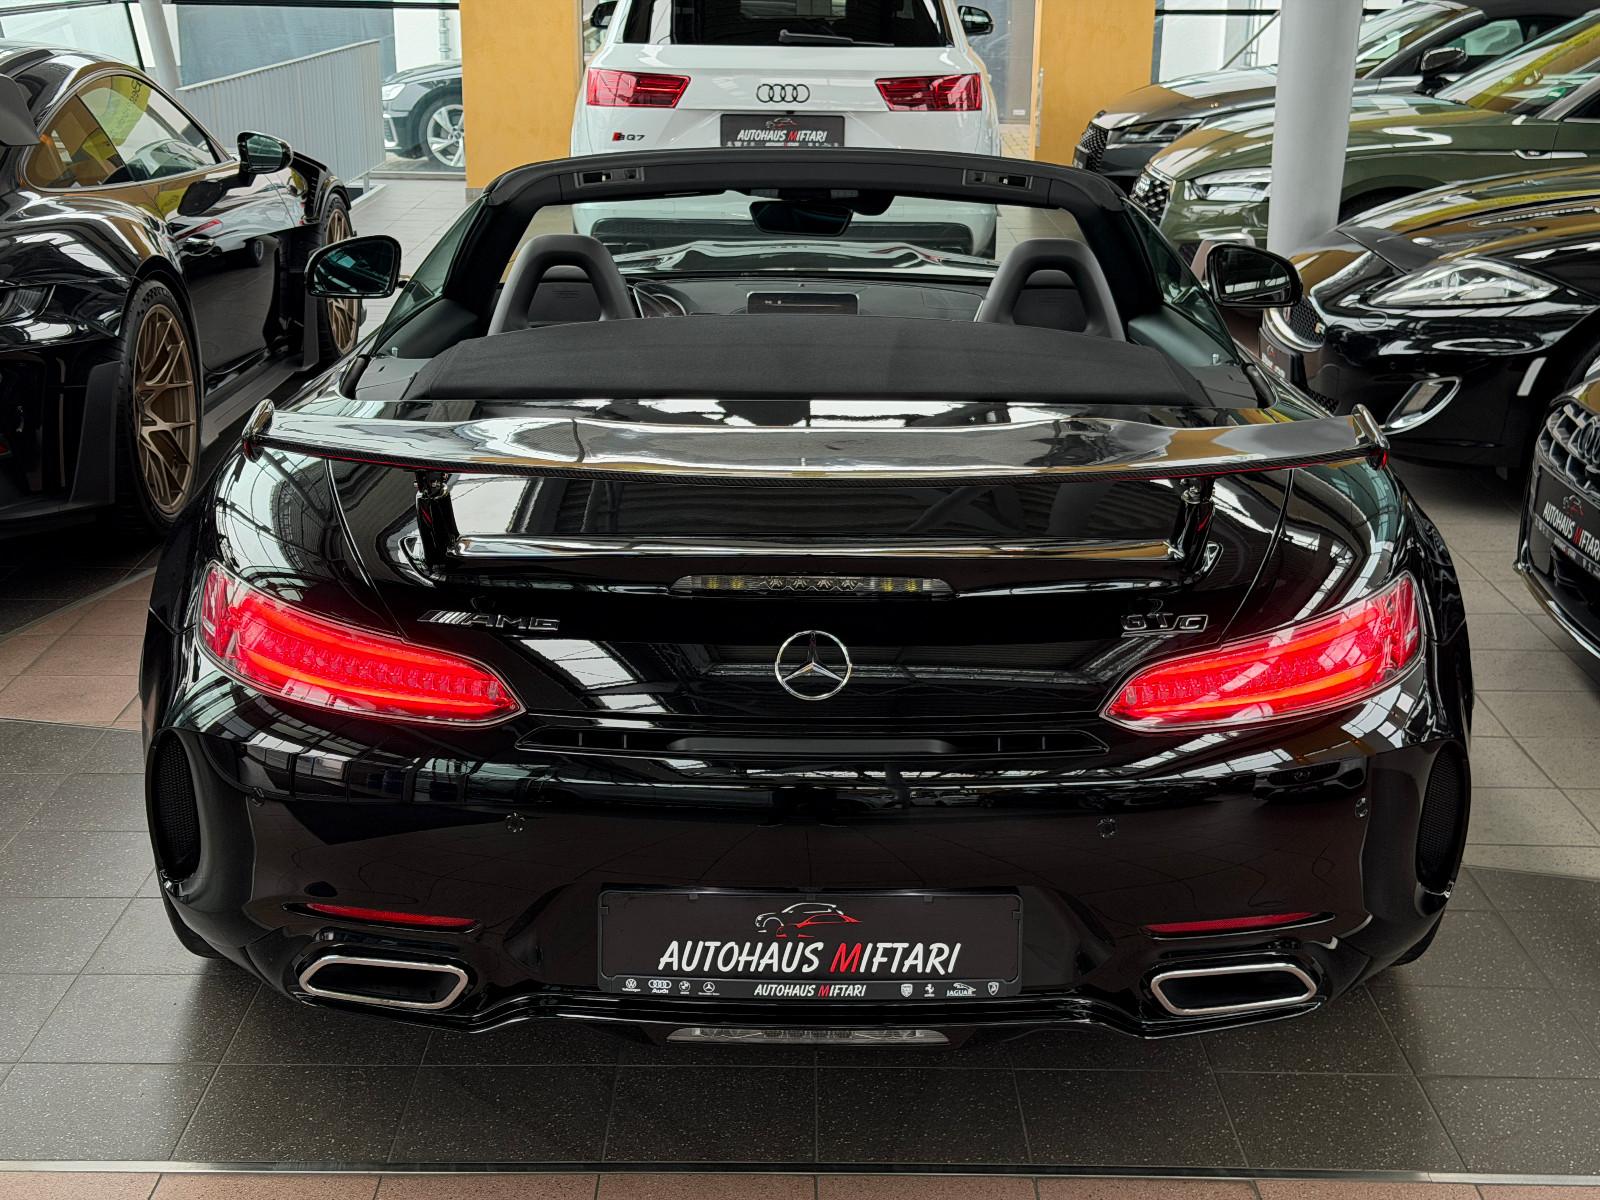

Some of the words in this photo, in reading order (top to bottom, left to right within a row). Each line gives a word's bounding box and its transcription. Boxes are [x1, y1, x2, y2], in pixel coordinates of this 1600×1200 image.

[736, 129, 786, 141] AUTOHAUS
[786, 130, 827, 142] MIFTARI
[1542, 501, 1576, 539] AUTOHAUS
[460, 613, 560, 630] AMG
[657, 940, 824, 974] AUTOHAUS
[829, 943, 962, 975] MIFTARI
[753, 984, 816, 997] AUTOHAUS
[818, 985, 866, 998] MIFTARI
